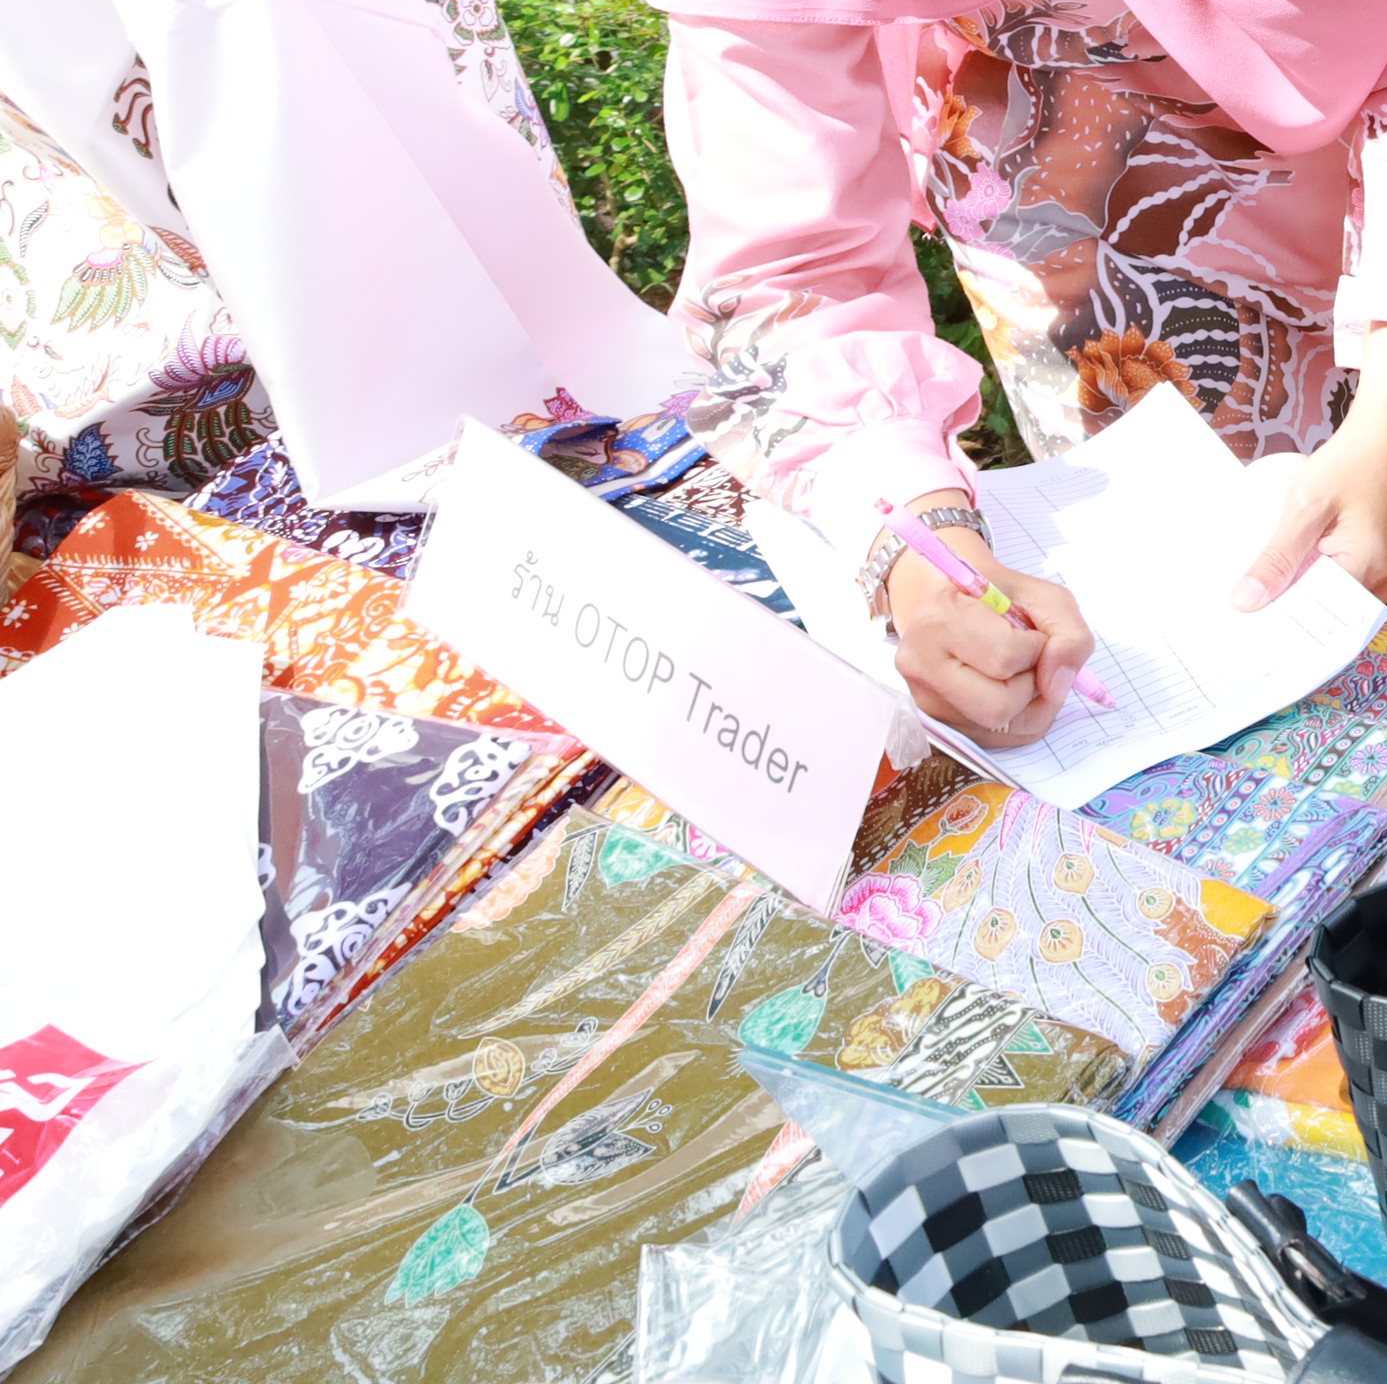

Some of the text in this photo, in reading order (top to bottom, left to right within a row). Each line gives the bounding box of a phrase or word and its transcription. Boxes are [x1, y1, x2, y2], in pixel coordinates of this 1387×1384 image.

[510, 550, 809, 794] ร้าน OTOP Trader
